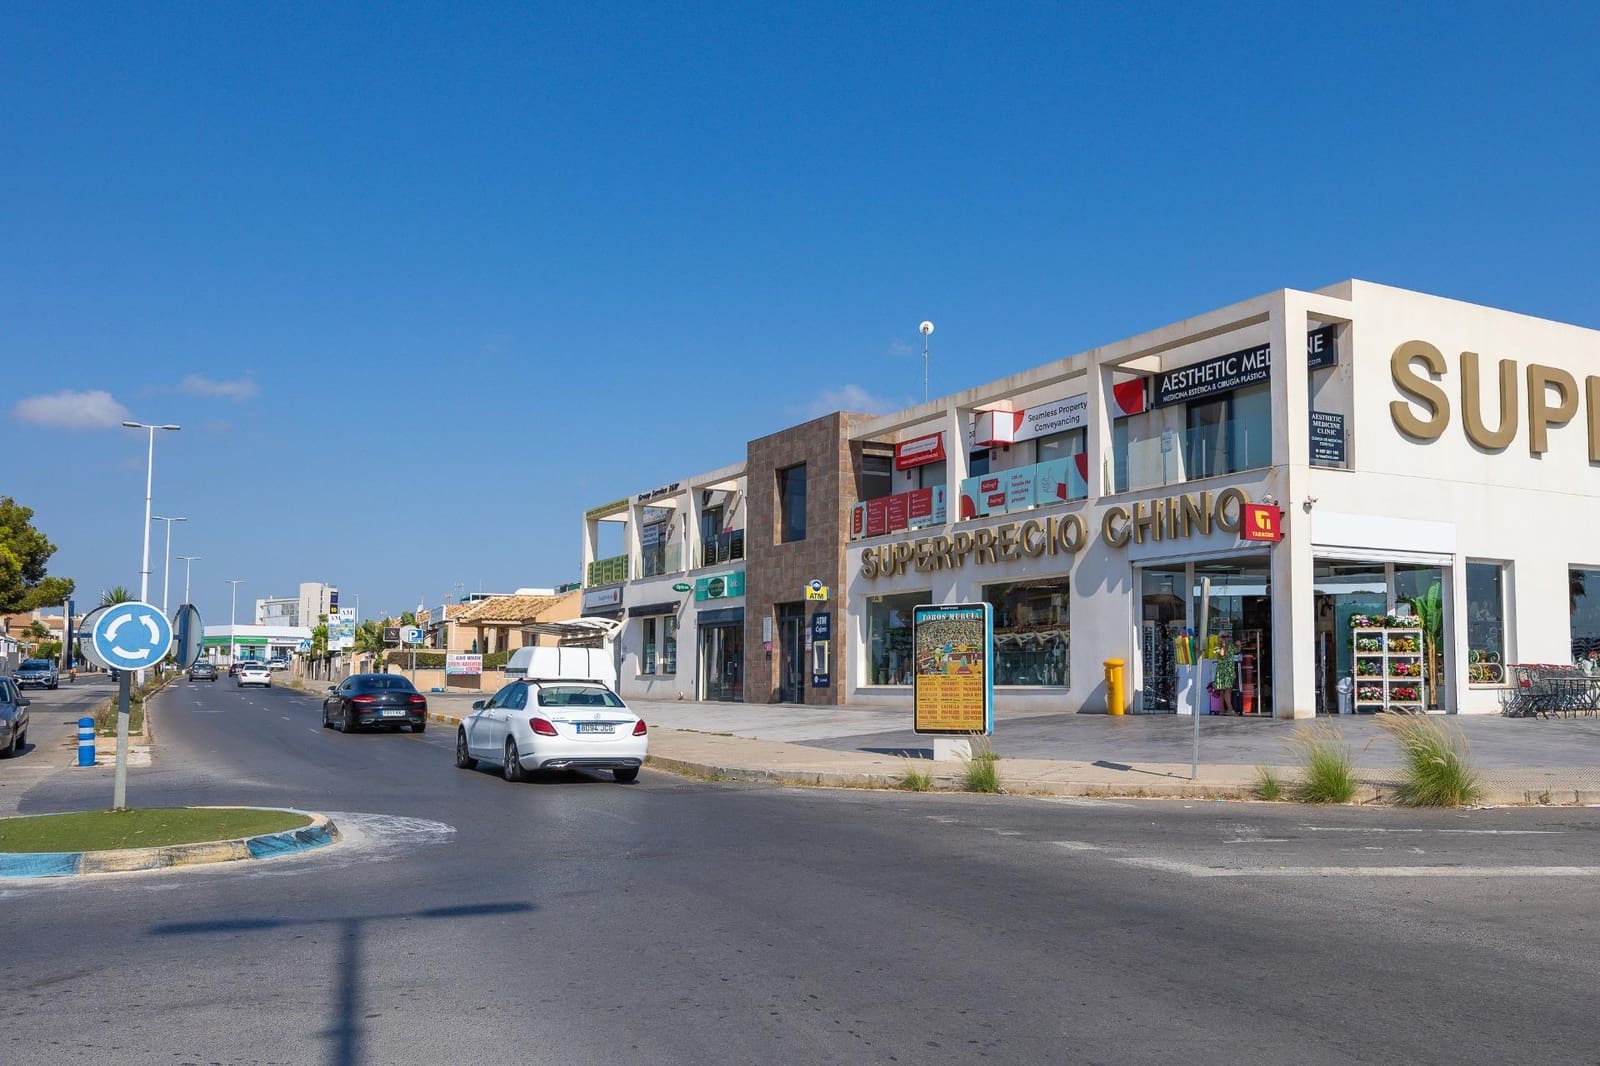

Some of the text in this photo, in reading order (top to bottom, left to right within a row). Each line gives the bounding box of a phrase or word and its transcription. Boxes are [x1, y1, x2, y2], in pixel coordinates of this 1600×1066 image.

[1161, 357, 1237, 393] AESTHETIC
[1162, 390, 1188, 402] MEDICINA
[1217, 376, 1240, 389] CIRUGÍA
[1240, 370, 1267, 383] PLÁSTICA
[1027, 400, 1088, 422] Seamless Property
[1389, 340, 1600, 462] SUP
[1034, 414, 1081, 432] Conveyancing
[1311, 413, 1343, 423] AESTHETIC
[1317, 428, 1337, 436] CLINIC
[861, 513, 1089, 579] SUPERPRECIO
[1102, 486, 1249, 548] CHINO
[922, 610, 979, 621] TOROS MURCIA
[410, 631, 418, 641] P
